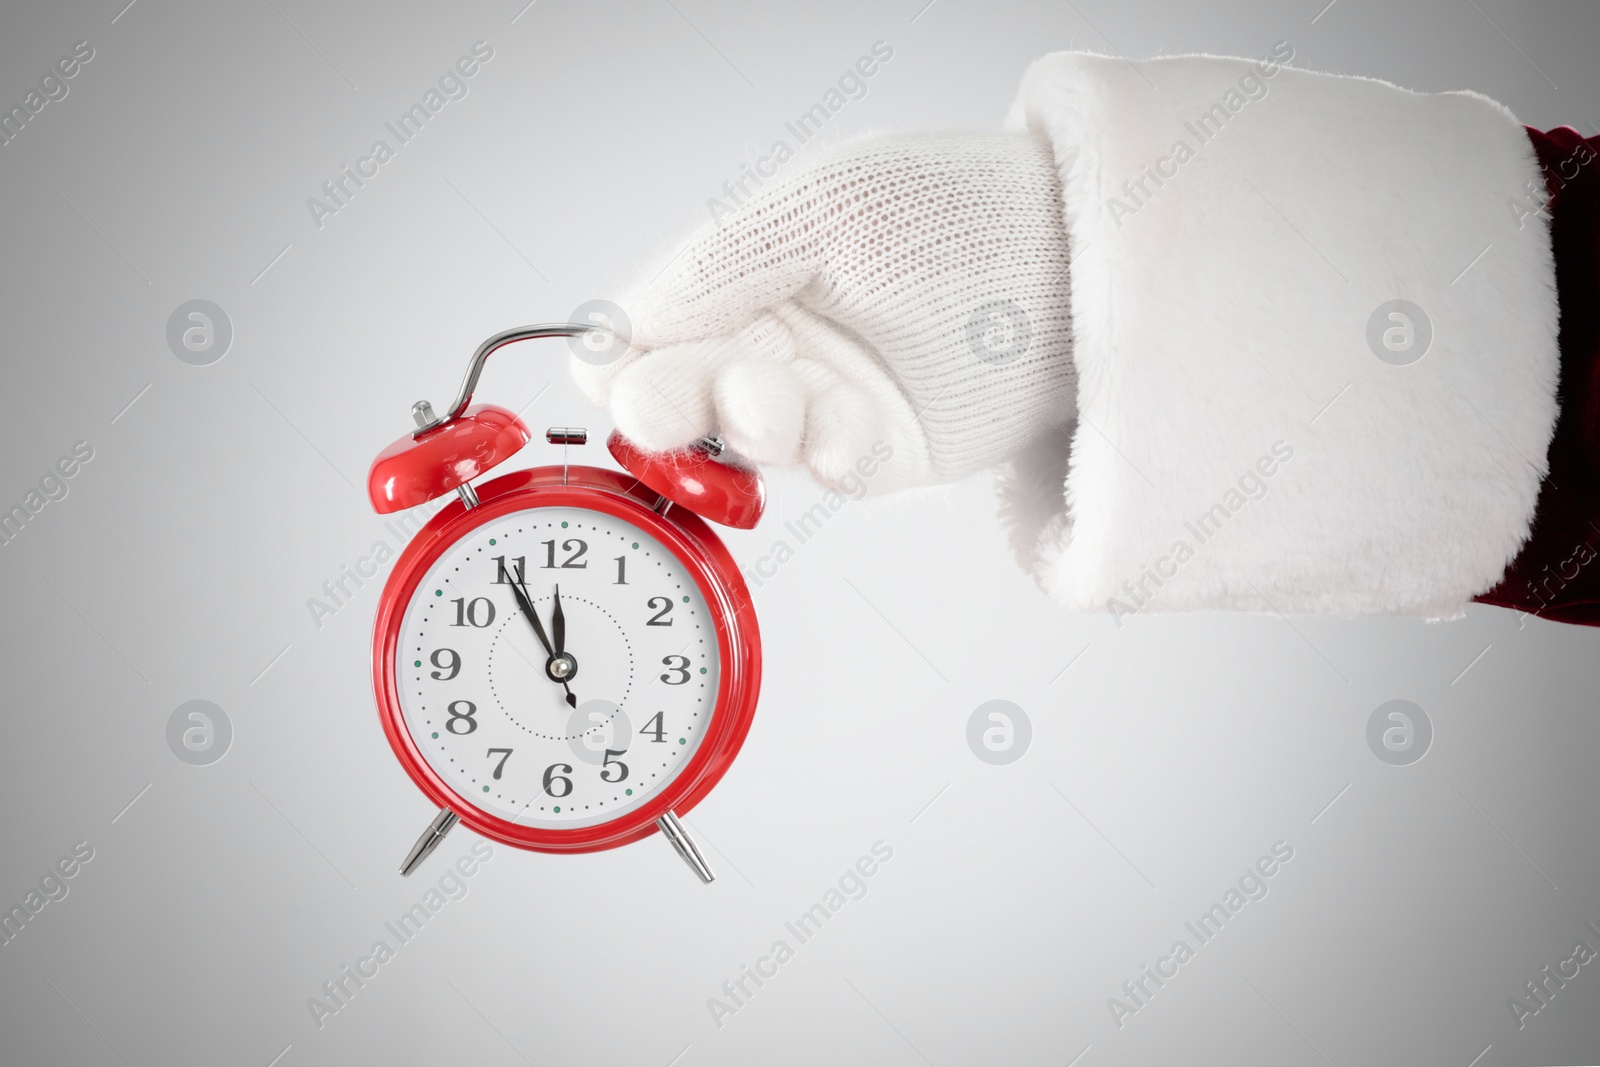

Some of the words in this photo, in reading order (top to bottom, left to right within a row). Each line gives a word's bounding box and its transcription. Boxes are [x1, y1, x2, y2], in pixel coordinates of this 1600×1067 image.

[540, 539, 588, 569] 12
[490, 555, 531, 585] 11
[612, 556, 630, 585] 1
[449, 597, 496, 628] 10
[646, 596, 674, 627] 2
[430, 648, 462, 681] 9
[660, 655, 691, 685] 3
[445, 700, 478, 735] 8
[639, 711, 668, 743] 4
[486, 748, 514, 780] 7
[600, 749, 629, 783] 5
[542, 763, 574, 798] 6
